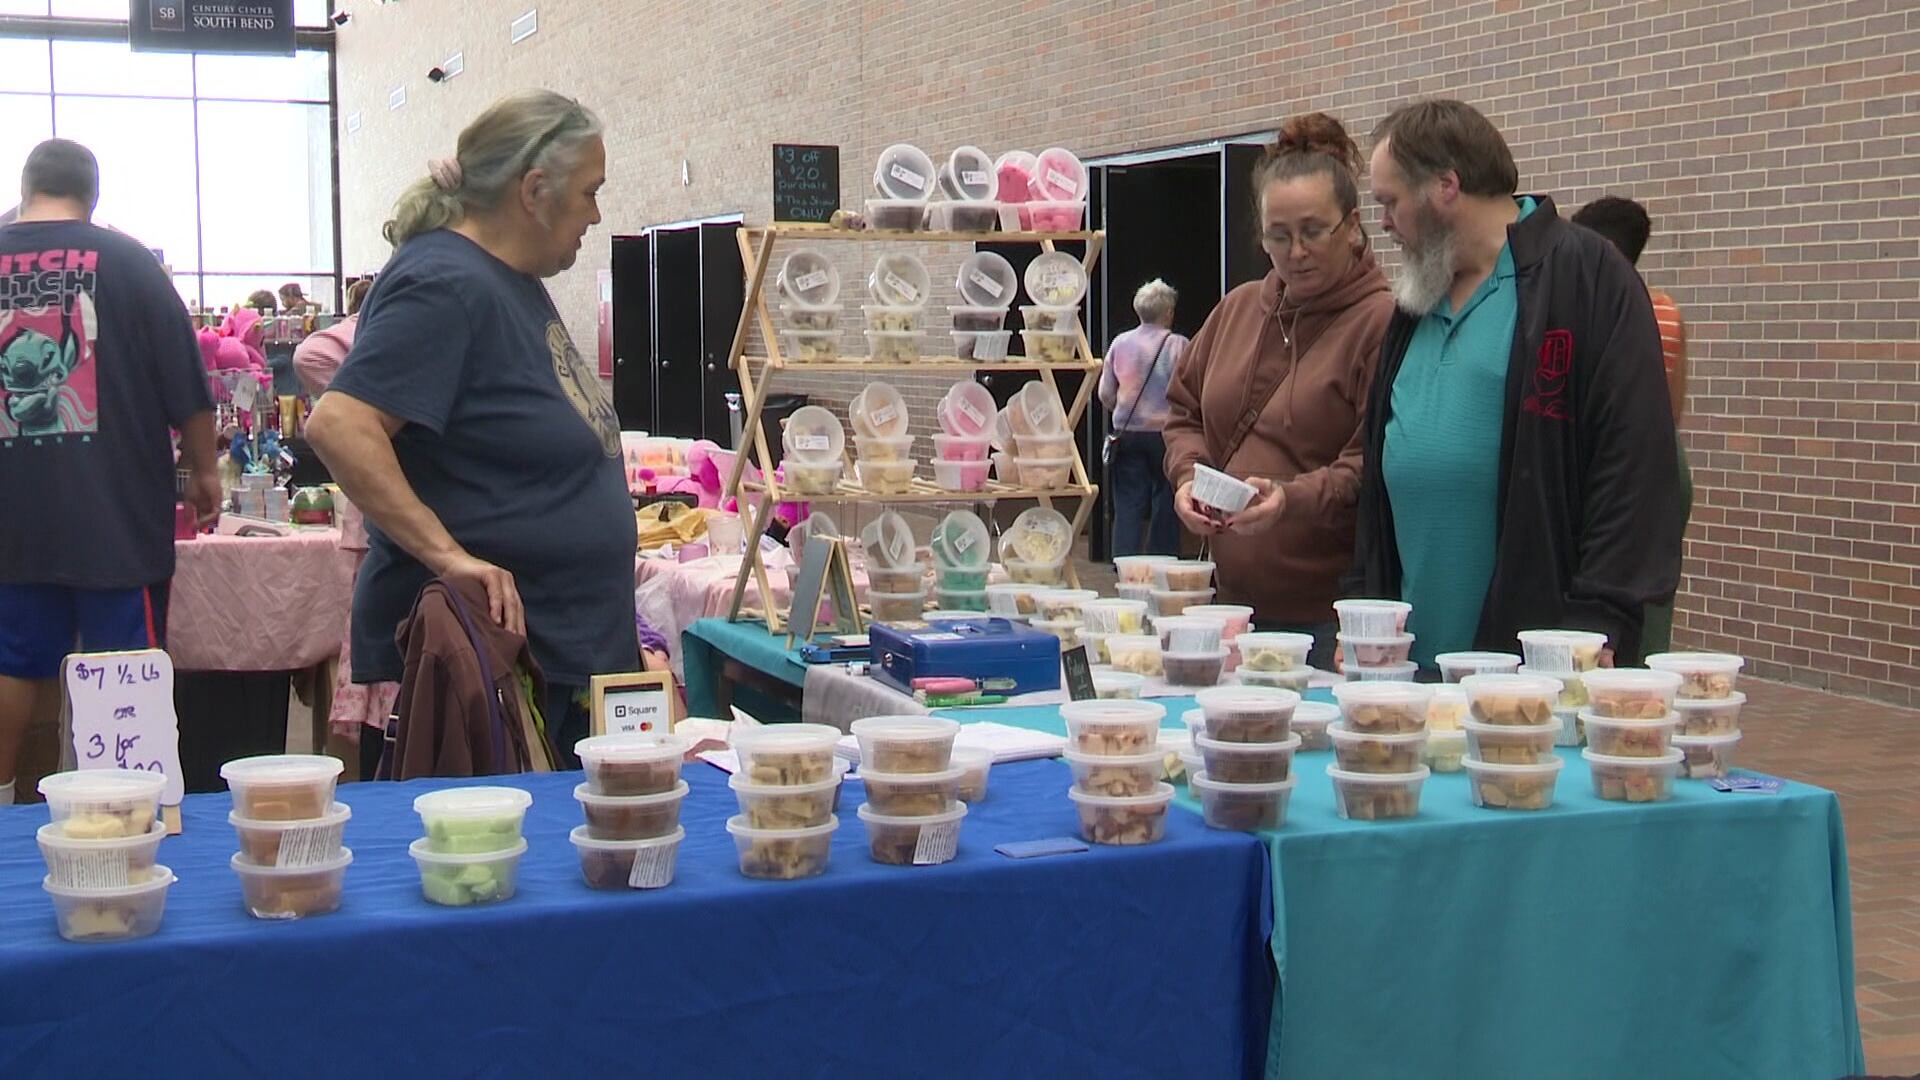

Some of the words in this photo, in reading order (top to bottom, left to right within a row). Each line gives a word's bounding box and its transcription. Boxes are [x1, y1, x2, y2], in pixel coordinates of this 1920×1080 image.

[159, 8, 176, 19] SB
[193, 5, 235, 13] CENTURY
[238, 6, 273, 14] CENTER
[194, 16, 236, 28] SOUTH
[240, 18, 274, 30] BEND
[75, 663, 104, 690] $7
[628, 705, 657, 716] Square
[87, 733, 105, 759] 3
